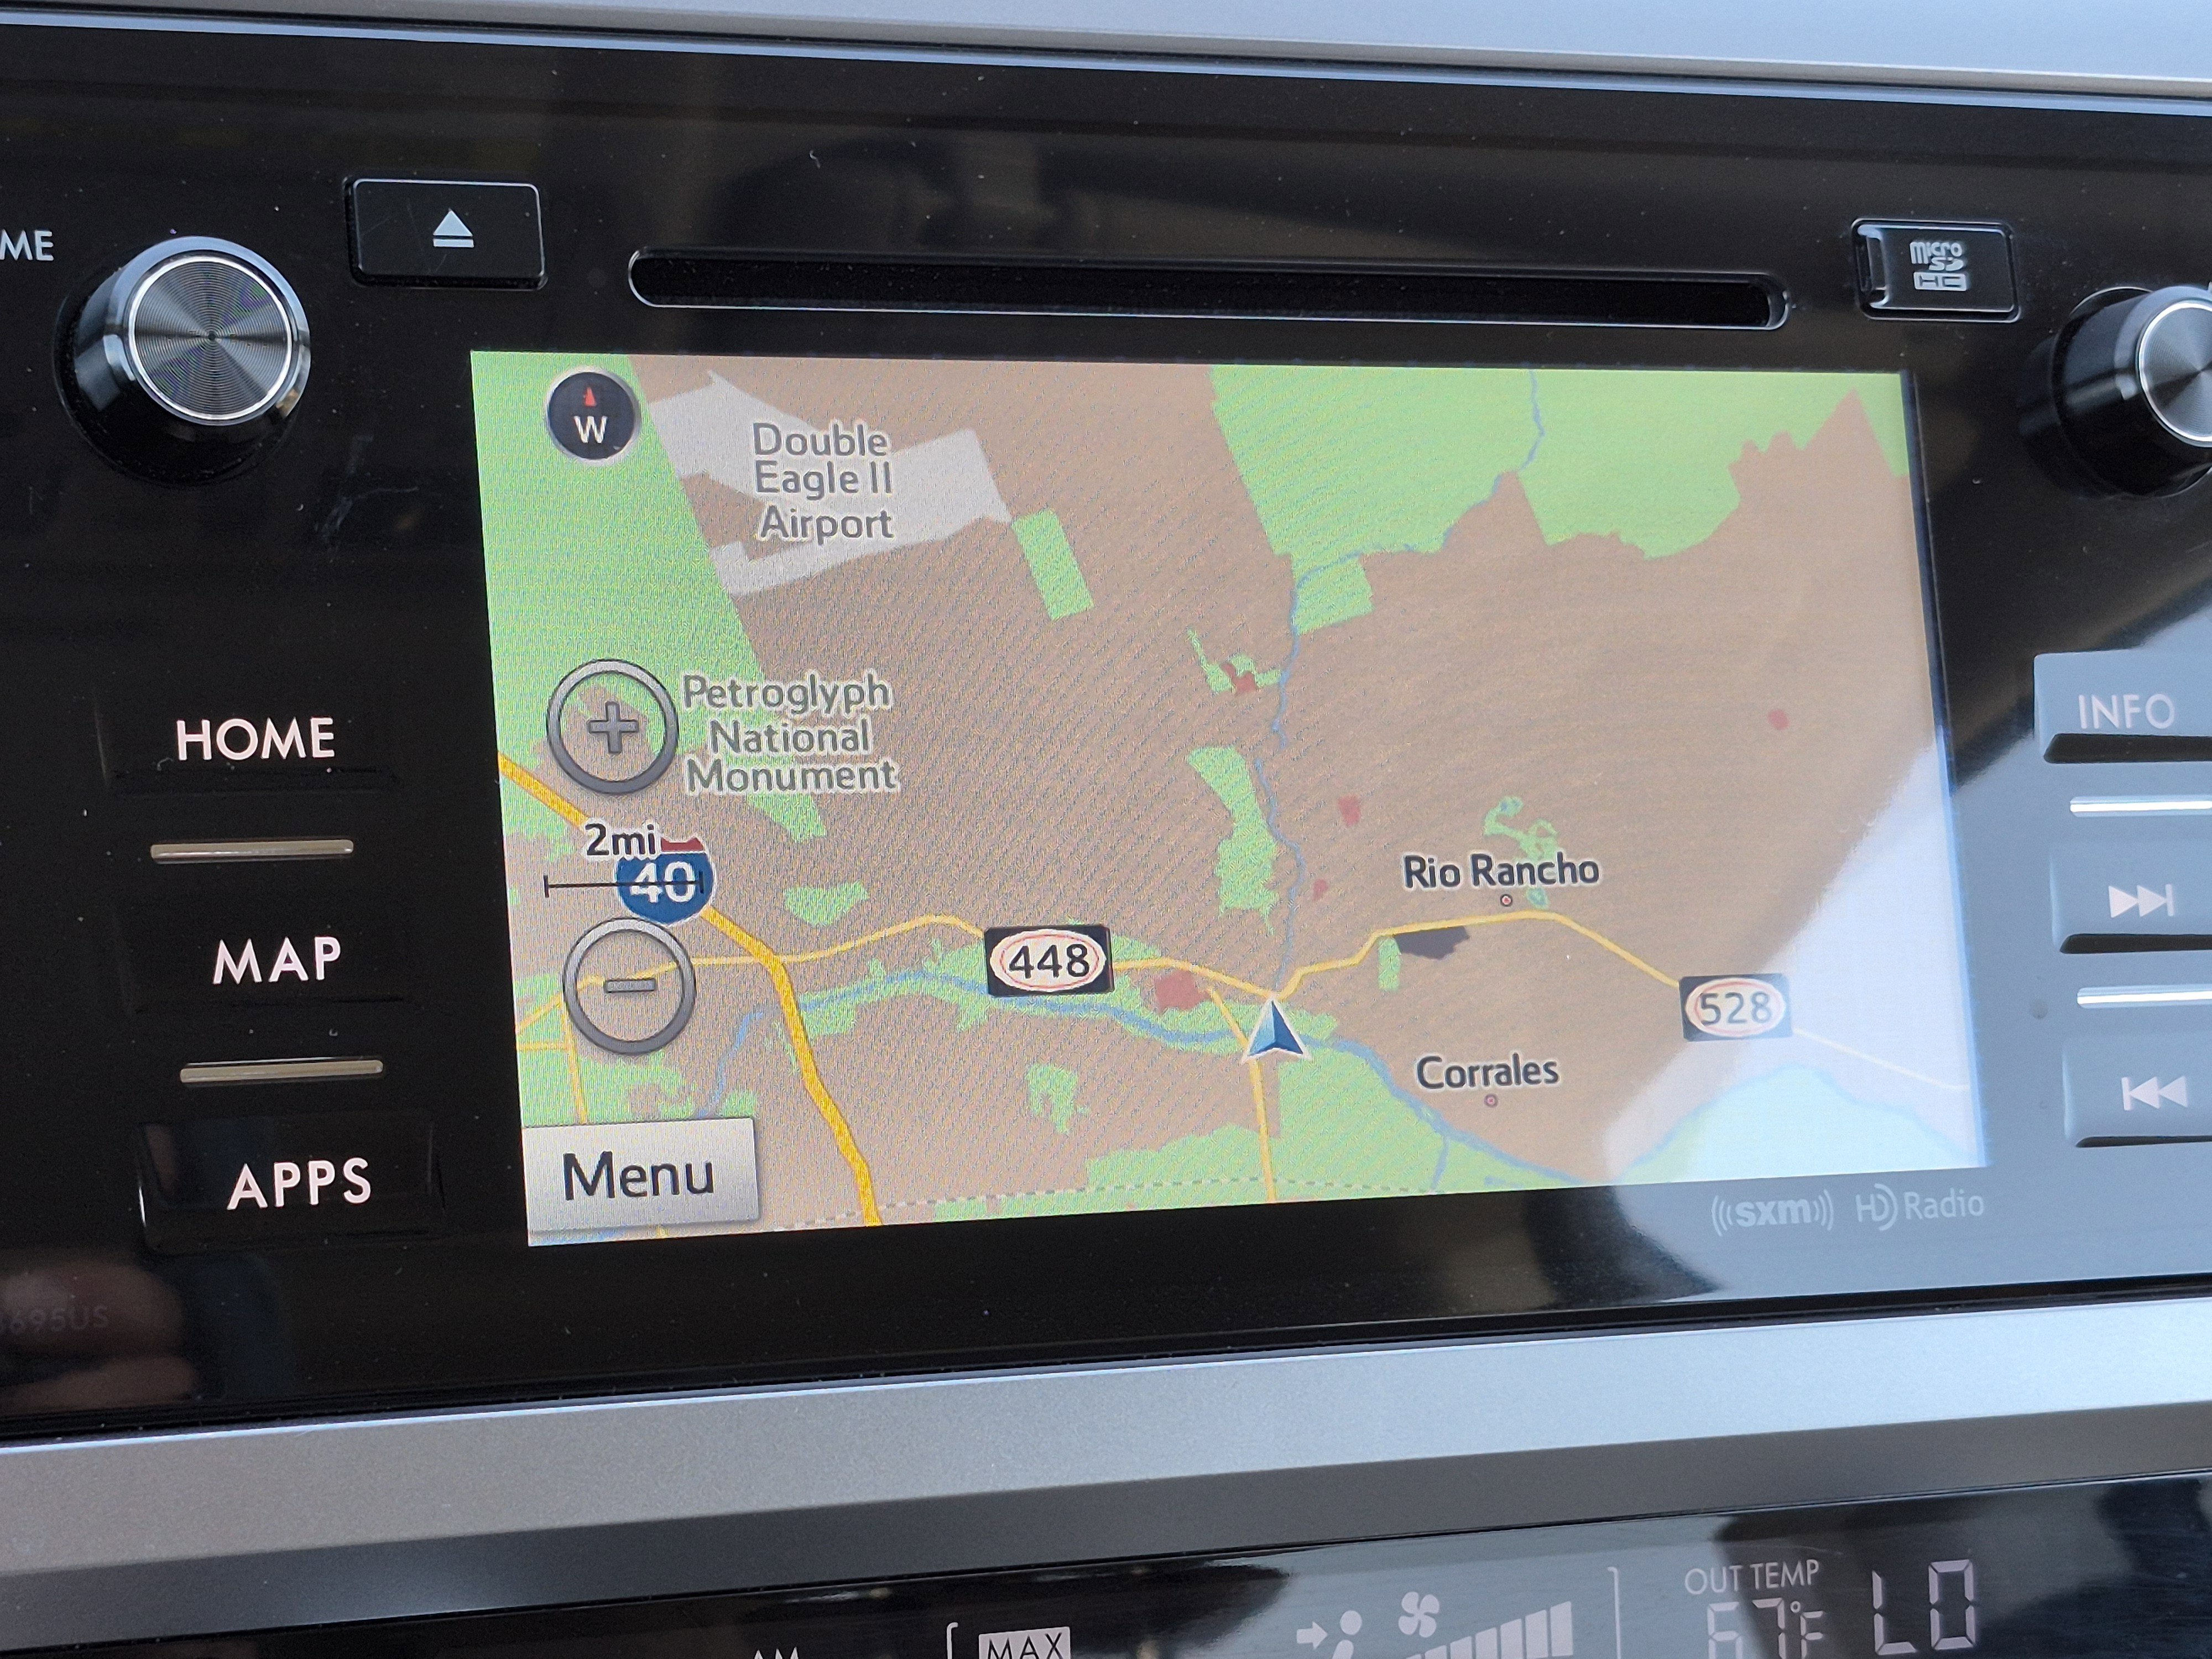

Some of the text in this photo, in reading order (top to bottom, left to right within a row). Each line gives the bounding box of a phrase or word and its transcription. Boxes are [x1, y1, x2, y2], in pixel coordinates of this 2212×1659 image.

[1910, 241, 1963, 264] micro
[573, 415, 608, 444] W
[753, 420, 888, 457] Double
[755, 460, 891, 501] Eagle II
[760, 505, 894, 545] Airport
[684, 673, 890, 715] Petroglyph
[2078, 692, 2176, 730] INFO
[176, 717, 335, 761] HOME
[711, 721, 869, 753] National
[688, 759, 897, 791] Monument
[586, 823, 657, 855] 2mi
[630, 861, 696, 904] 40
[1405, 852, 1599, 888] Rio Rancho
[212, 936, 341, 984] MAP
[1008, 943, 1090, 979] 448
[1699, 992, 1772, 1025] 528
[1417, 1053, 1559, 1089] Corrales
[227, 1157, 372, 1211] APPS
[562, 1150, 714, 1200] Menu
[1856, 1183, 1984, 1230] HD Radio
[1685, 1559, 1820, 1594] OUT TEMP
[988, 1632, 1063, 1659] MAX
